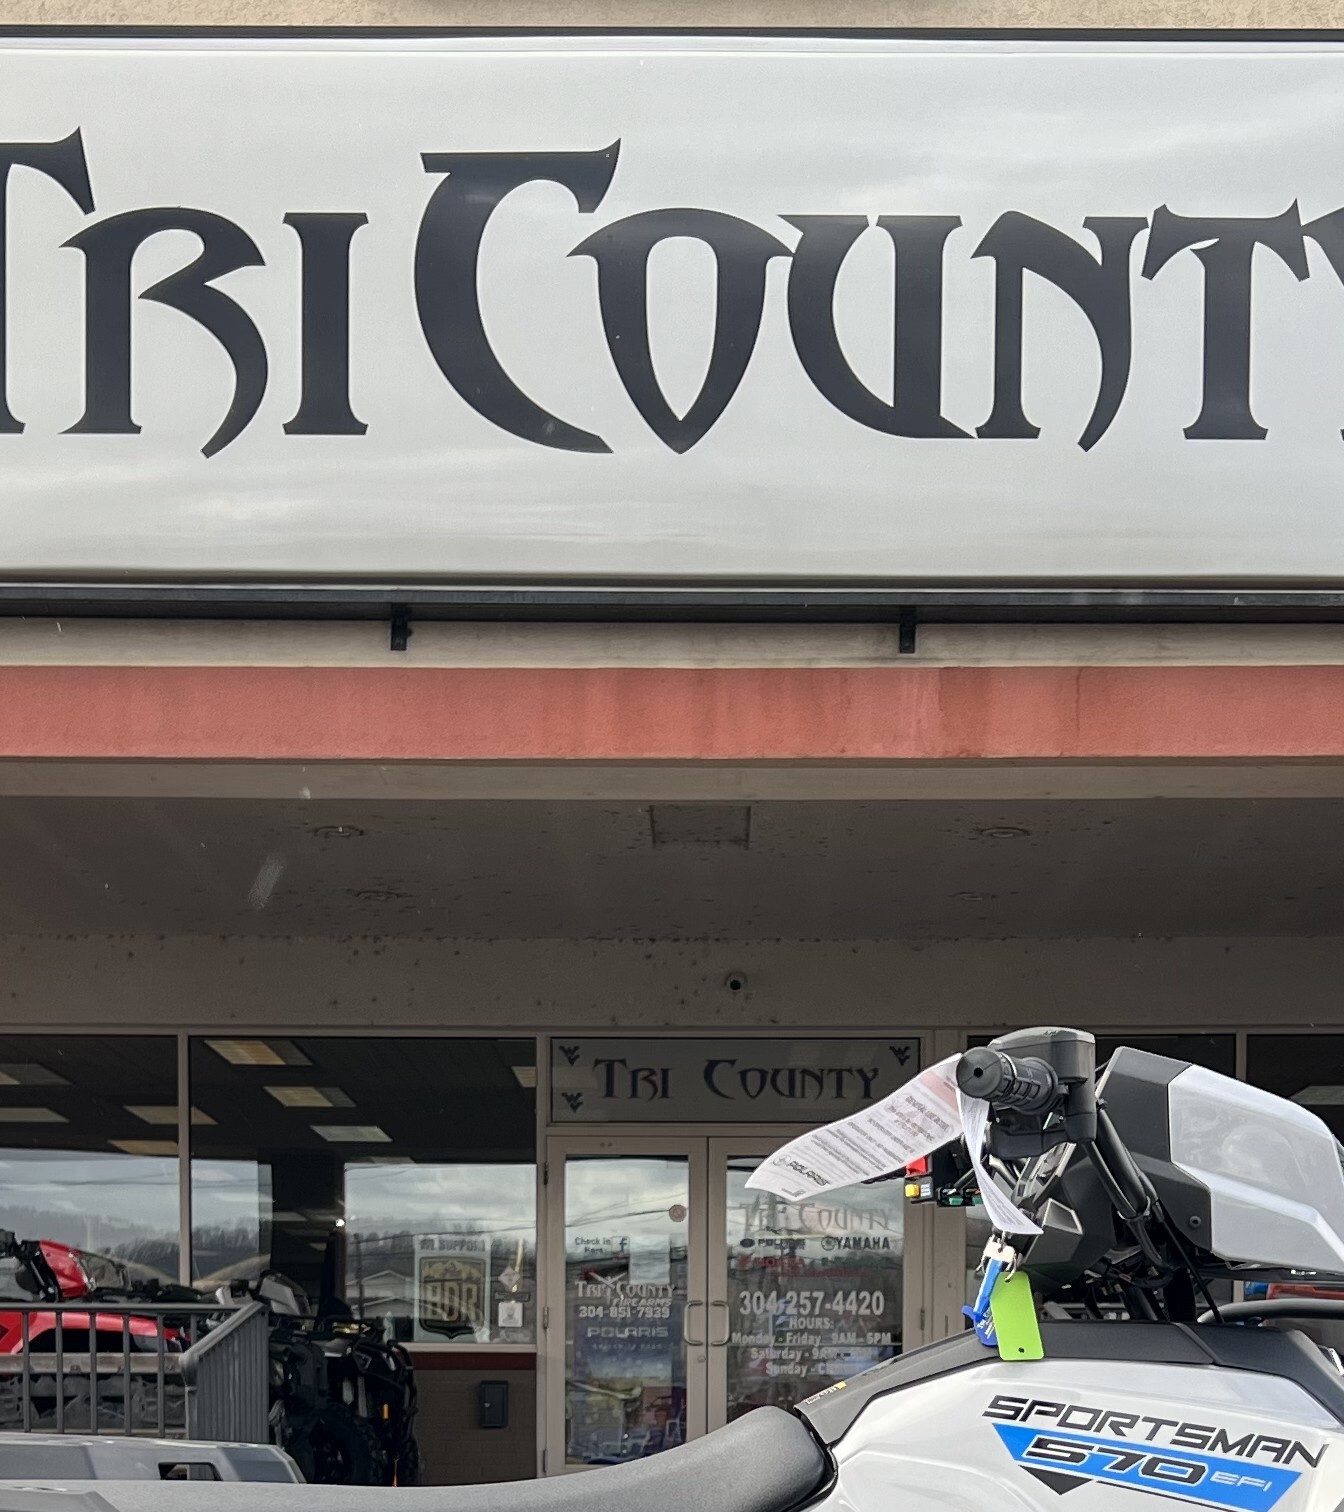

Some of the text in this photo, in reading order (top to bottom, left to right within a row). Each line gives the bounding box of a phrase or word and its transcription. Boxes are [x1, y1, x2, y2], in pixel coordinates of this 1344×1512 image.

[593, 1058, 879, 1101] TRI COUNTY
[835, 1236, 891, 1250] YAMAHA
[615, 1281, 675, 1299] COUNTY
[739, 1290, 885, 1315] 304-257-4420
[788, 1317, 834, 1329] HOURS:
[586, 1326, 669, 1338] POLARIS
[731, 1332, 776, 1346] Monday
[786, 1332, 822, 1346] Friday
[750, 1347, 801, 1361] Saturday
[765, 1362, 809, 1377] Sunday
[981, 1394, 1330, 1468] SPORTSMAN
[1022, 1433, 1273, 1492] 570 EFI
